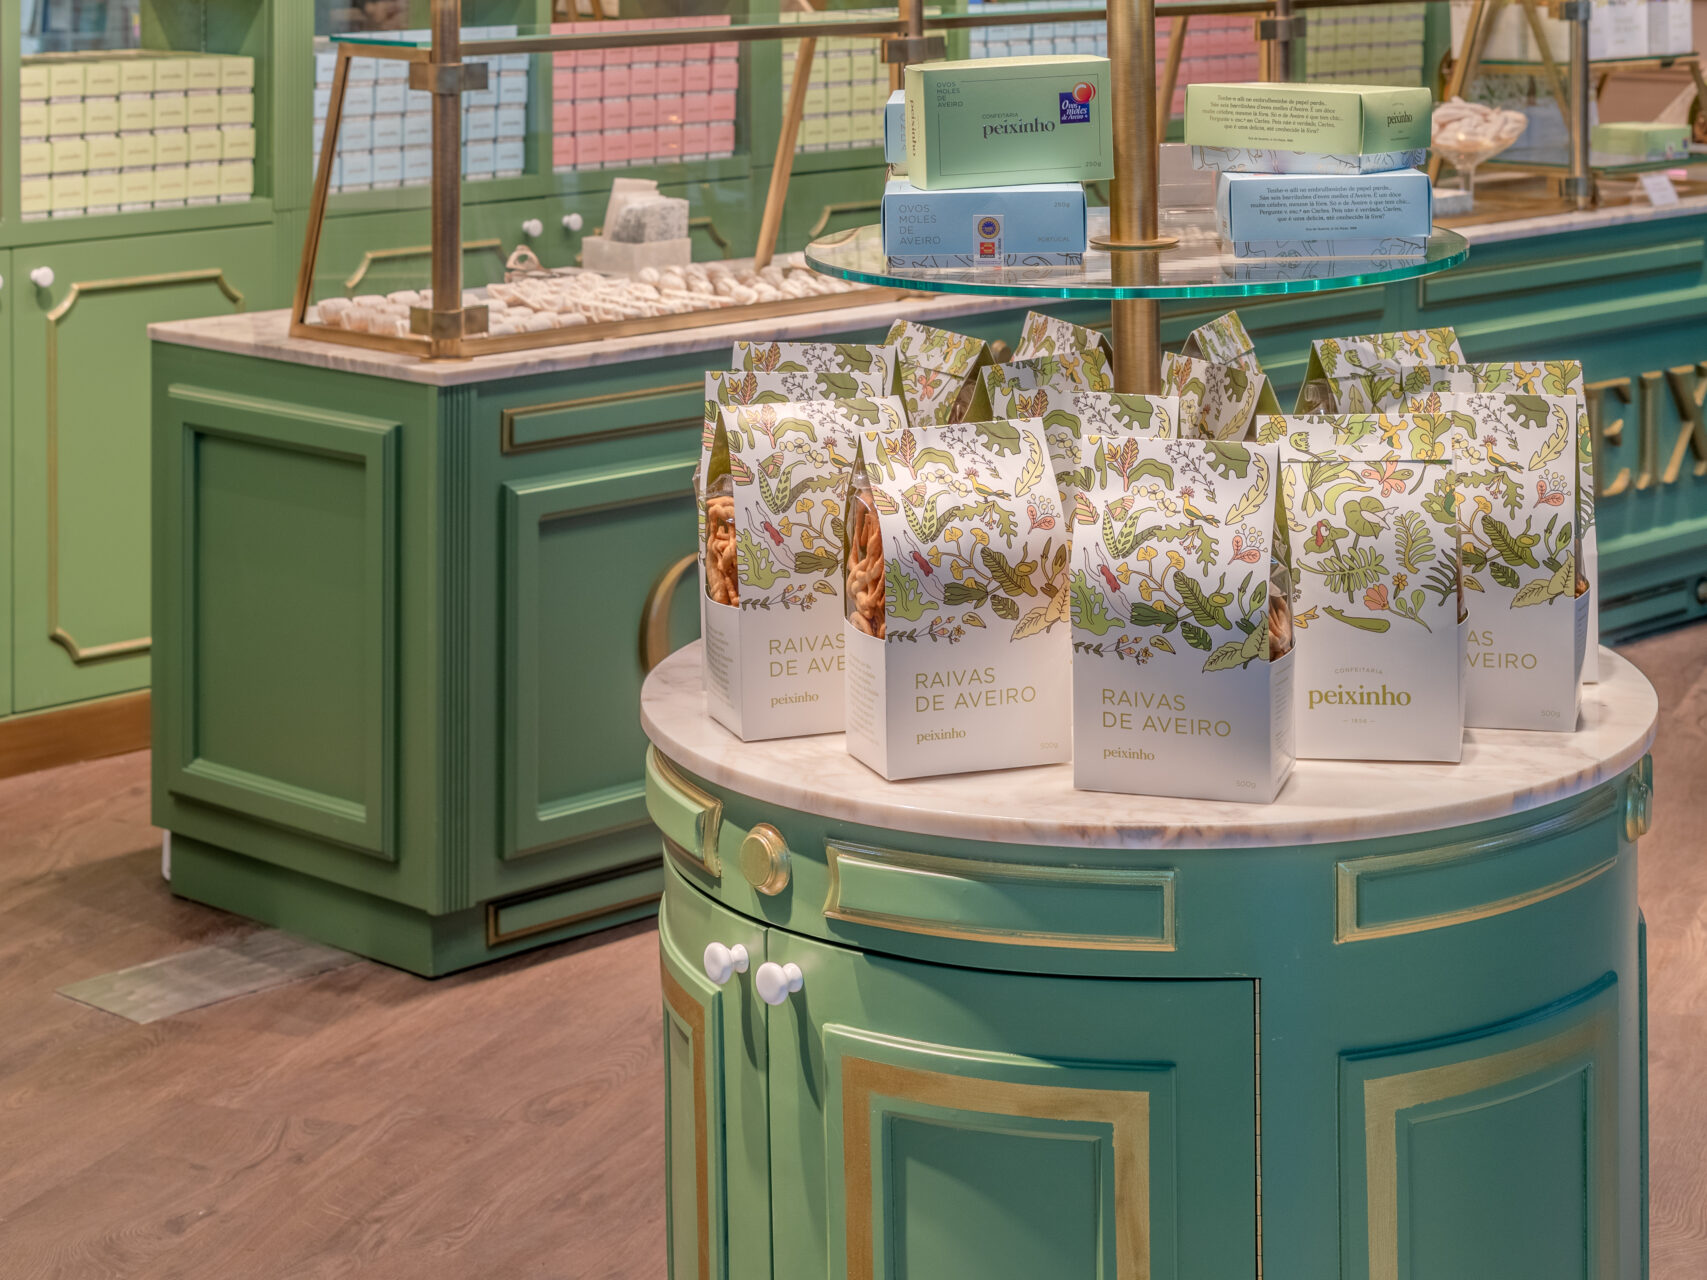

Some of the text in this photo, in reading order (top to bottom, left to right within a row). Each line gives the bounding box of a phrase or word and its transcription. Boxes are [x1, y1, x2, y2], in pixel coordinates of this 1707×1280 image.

[1061, 99, 1078, 110] Ovos
[1066, 105, 1088, 115] moles
[983, 116, 1056, 139] peixinho
[898, 204, 930, 213] OVOS
[899, 214, 937, 224] MOLES
[899, 226, 914, 235] DE
[900, 236, 942, 245] AVEIRO
[768, 633, 845, 655] RAIVAS
[769, 659, 798, 678] DE
[1334, 667, 1383, 675] CONFEITARIA
[915, 667, 995, 689] RAIVAS
[770, 691, 819, 708] peixinho
[915, 686, 1036, 713] DE AVEIRO
[1102, 688, 1186, 712] RAIVAS
[1308, 684, 1412, 710] peixinho
[1541, 709, 1560, 718] 500g
[1102, 711, 1232, 737] DE AVEIRO
[916, 727, 966, 744] peixinho
[1103, 747, 1155, 761] peixinho
[1235, 780, 1257, 789] 500g
